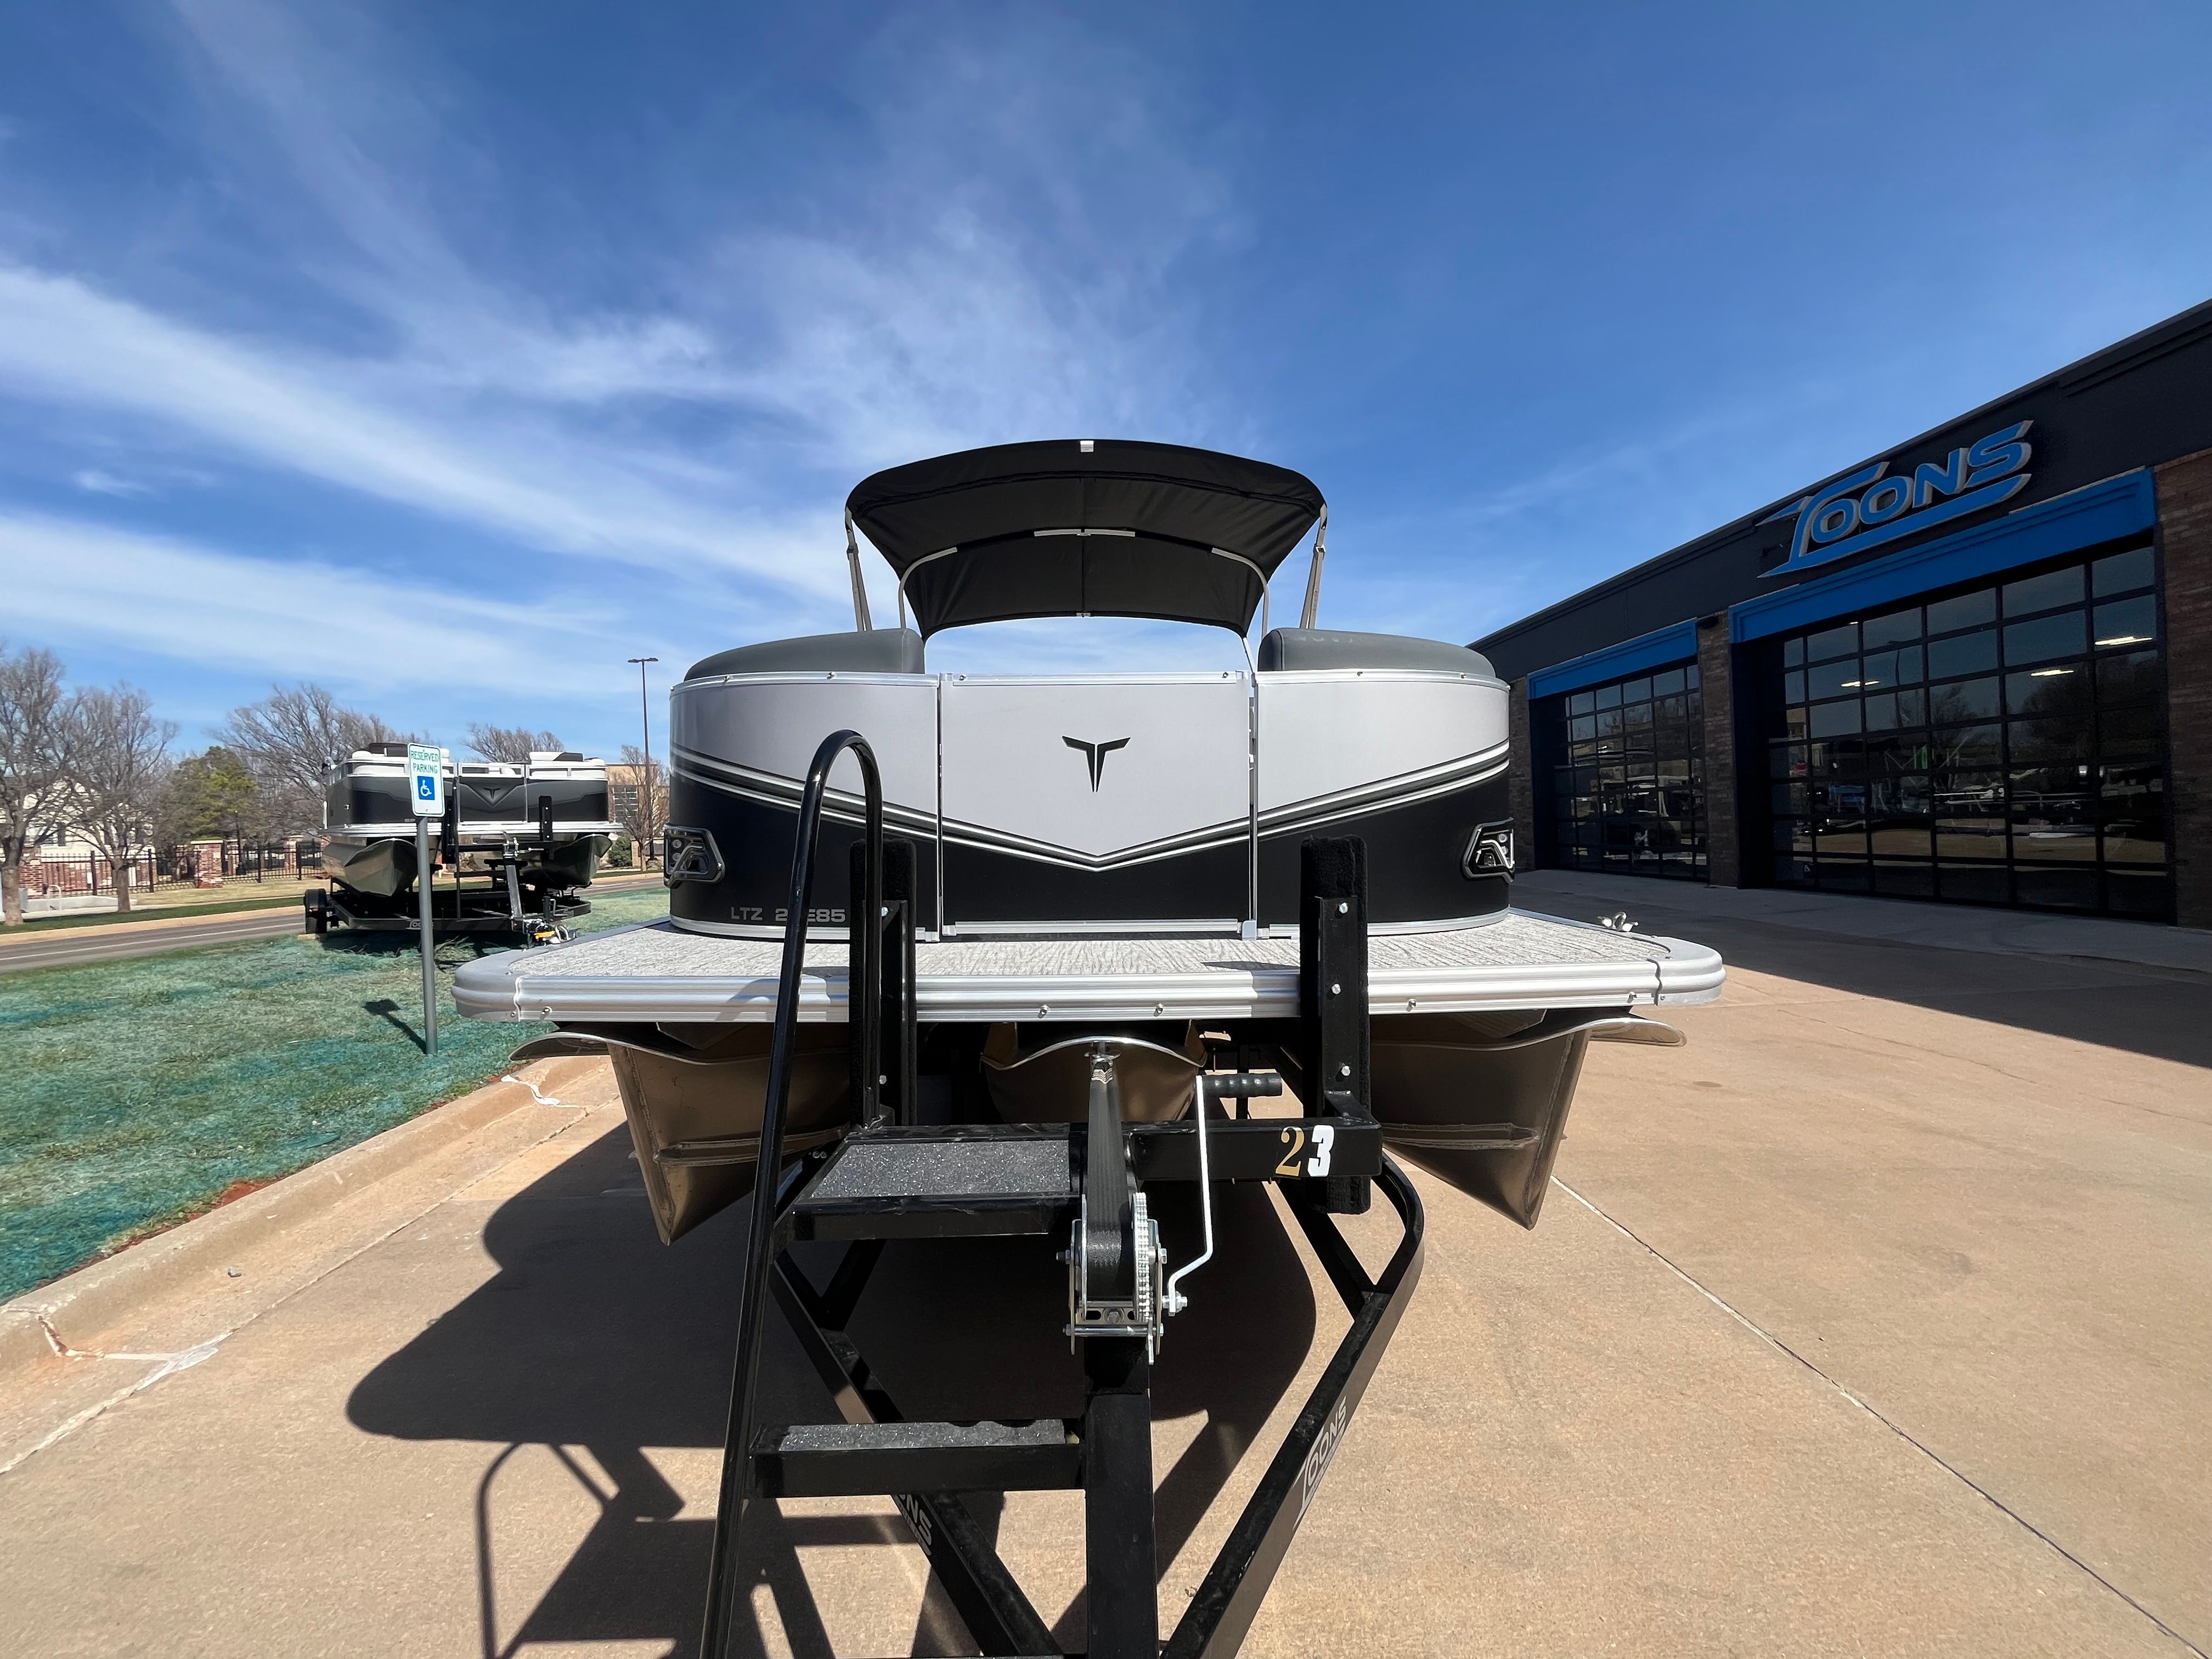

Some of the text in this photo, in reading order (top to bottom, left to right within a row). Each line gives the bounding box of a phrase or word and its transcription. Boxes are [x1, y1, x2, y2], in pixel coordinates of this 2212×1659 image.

[411, 750, 439, 762] RESERVED
[413, 763, 438, 774] PARKING
[731, 906, 845, 923] LTZ 2E85
[1275, 1125, 1335, 1177] 23
